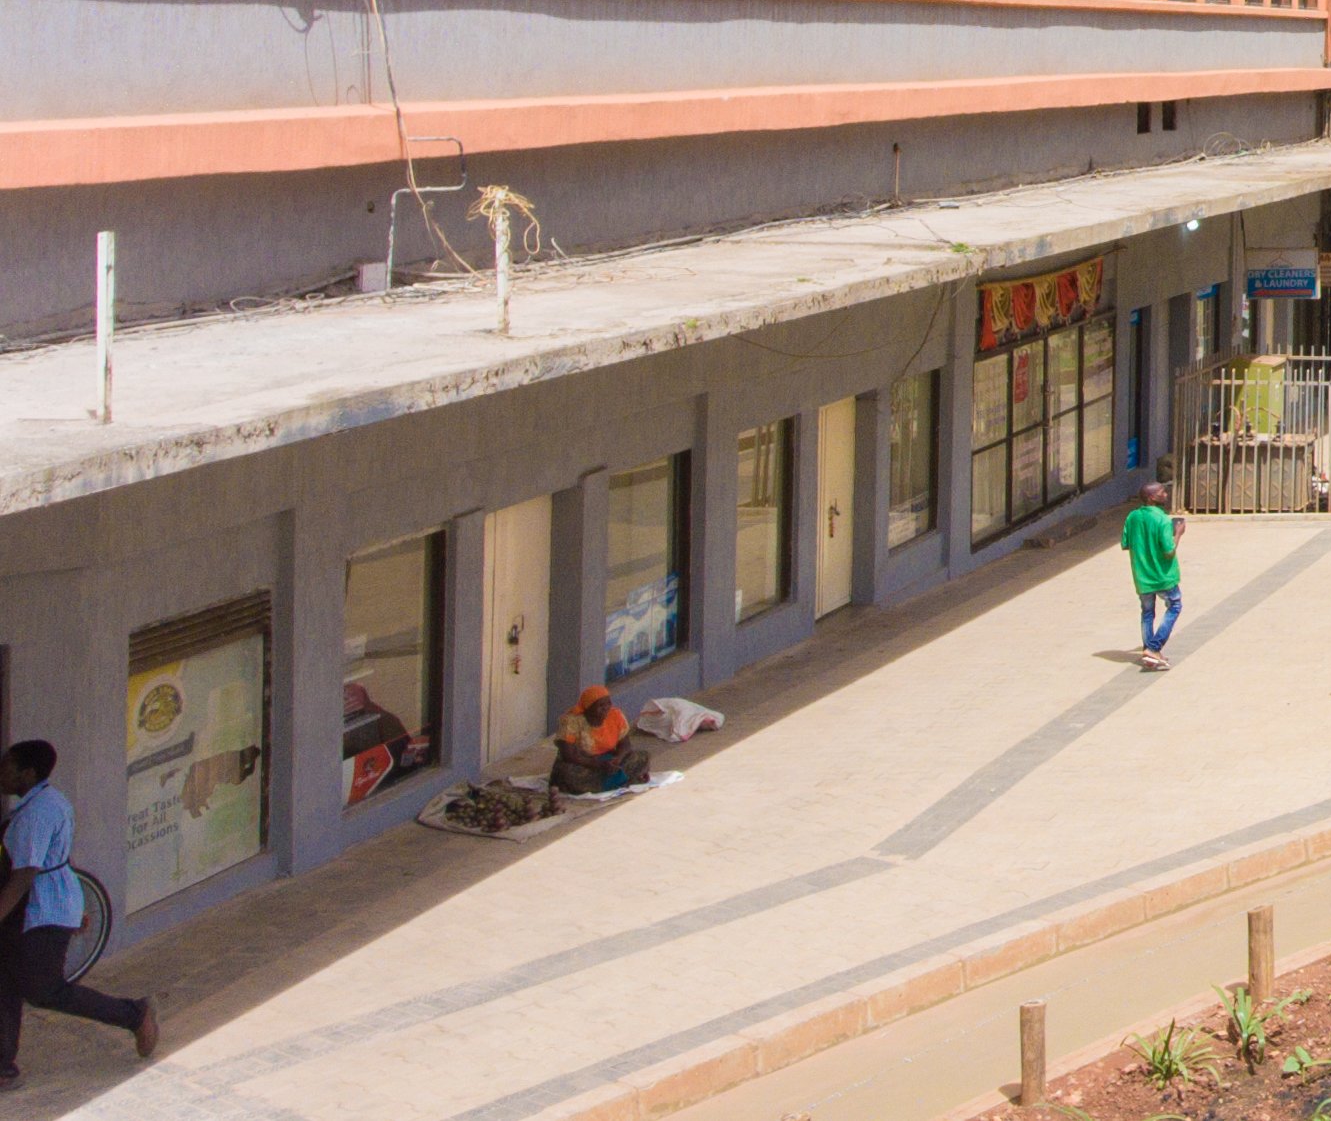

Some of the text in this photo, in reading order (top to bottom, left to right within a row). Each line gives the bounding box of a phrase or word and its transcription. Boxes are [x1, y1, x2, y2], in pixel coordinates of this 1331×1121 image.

[1248, 270, 1266, 278] DRY
[1268, 269, 1316, 278] CLEANERS
[1264, 279, 1308, 288] LAUNDRY
[128, 806, 149, 822] reat
[131, 812, 167, 836] for All
